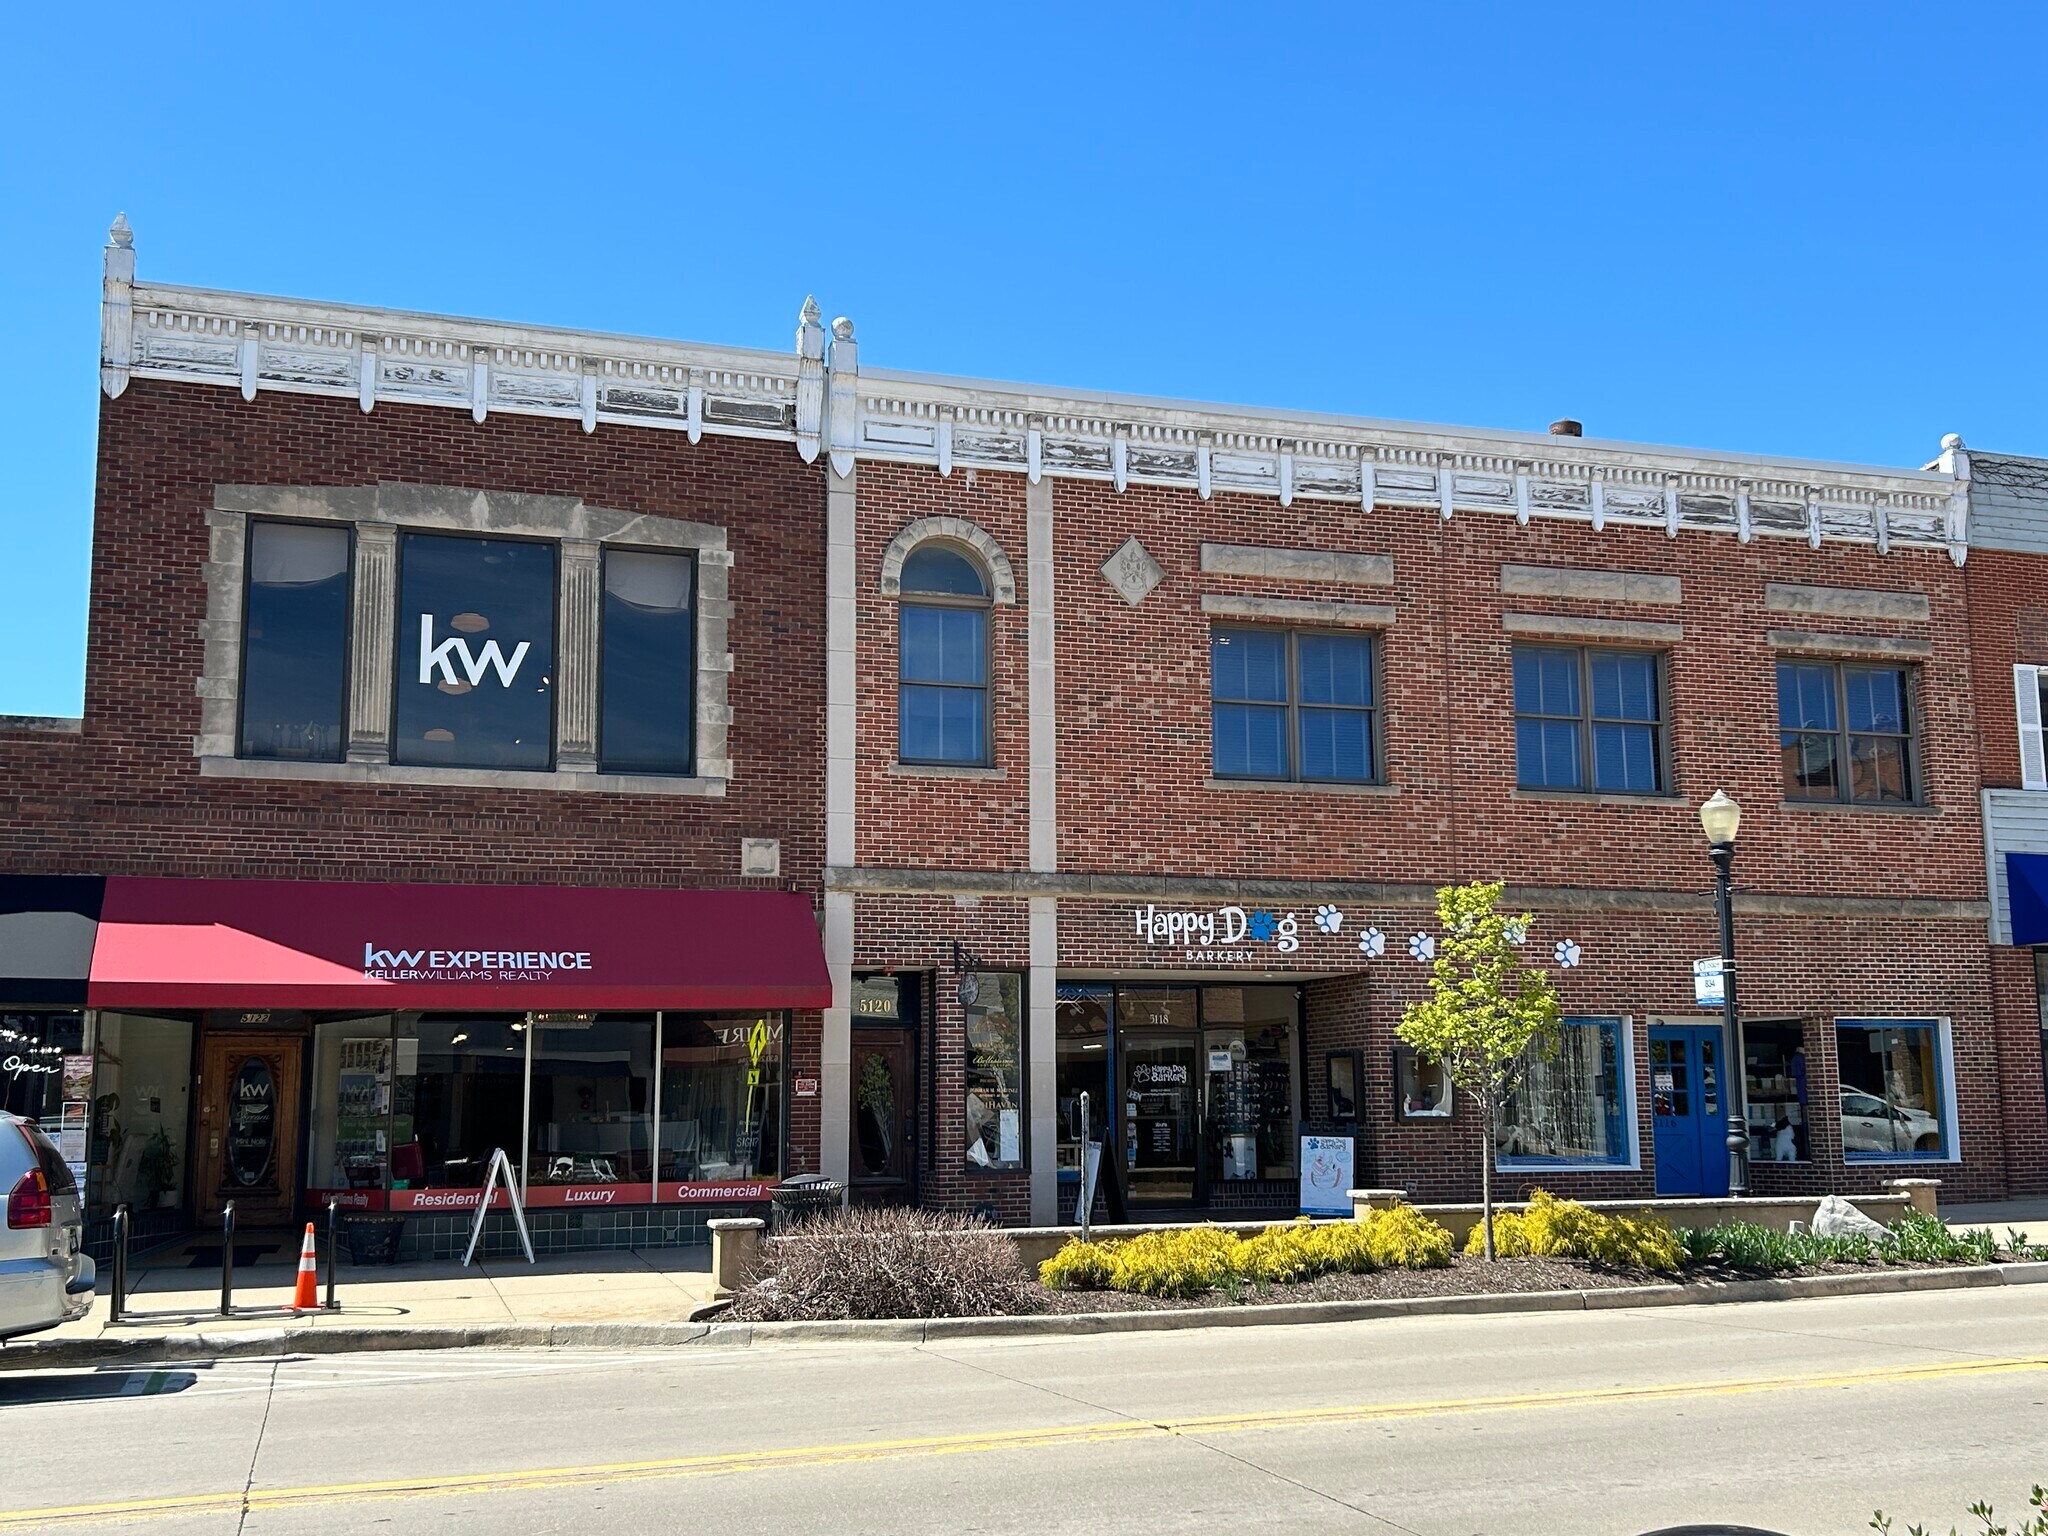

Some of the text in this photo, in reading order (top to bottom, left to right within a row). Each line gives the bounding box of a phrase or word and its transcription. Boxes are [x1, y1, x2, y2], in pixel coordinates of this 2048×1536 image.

[418, 613, 531, 688] kw
[1135, 904, 1214, 945] Happy
[364, 942, 593, 970] kw EXPERIENCE
[1185, 949, 1254, 963] BARKERY
[499, 970, 553, 981] REALTY
[1704, 979, 1716, 988] 834
[859, 999, 891, 1014] 5120
[240, 1013, 270, 1024] 5122
[1149, 1013, 1170, 1025] 5118
[3, 1055, 60, 1081] Open
[1151, 1064, 1187, 1075] Happy Dog
[239, 1078, 270, 1098] kw
[413, 1191, 499, 1206] Residental
[564, 1188, 617, 1203] Luxury
[677, 1184, 763, 1199] Commercial
